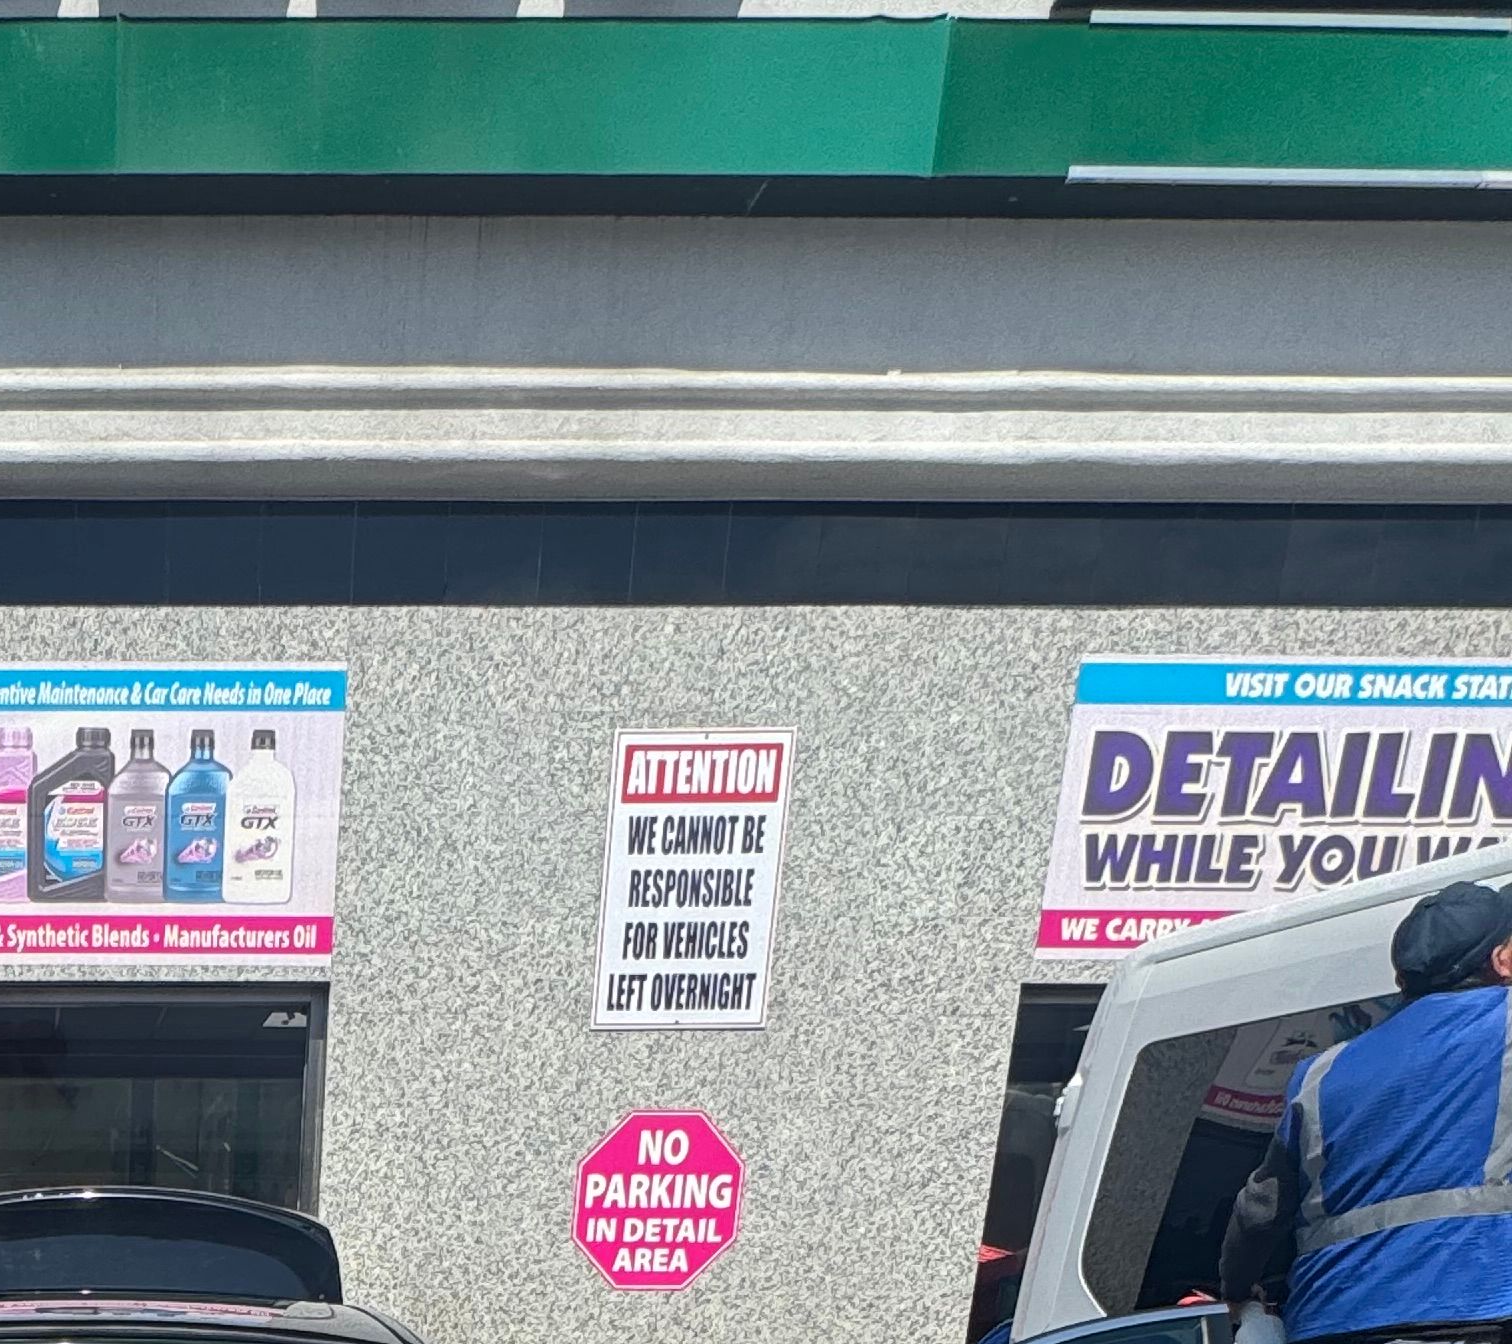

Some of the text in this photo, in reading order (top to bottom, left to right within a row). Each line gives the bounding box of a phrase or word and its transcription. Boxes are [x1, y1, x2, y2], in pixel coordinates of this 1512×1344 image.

[37, 681, 127, 705] Maintenance
[128, 682, 142, 705] &
[143, 682, 169, 705] Car
[170, 682, 200, 705] Care
[200, 682, 245, 705] Needs
[245, 683, 262, 705] in
[263, 683, 292, 705] One
[293, 682, 332, 706] Place
[1224, 671, 1287, 698] VISIT
[1293, 672, 1352, 699] OUR
[1357, 672, 1449, 700] SNACK
[626, 748, 777, 796] ATTENTION
[122, 814, 155, 828] GTX
[180, 814, 215, 826] GTX
[240, 816, 279, 830] GTX
[626, 814, 767, 857] WE CANNOT BE
[1082, 832, 1270, 891] WHILE
[1278, 832, 1406, 889] YOU
[628, 867, 755, 910] RESPONSIBLE
[6, 923, 88, 953] Synthetic
[92, 924, 150, 949] Blends
[164, 923, 290, 950] Manufacturers
[293, 924, 318, 949] Oil
[621, 921, 750, 962] FOR VEHICLES
[1060, 917, 1100, 942] WE
[605, 972, 757, 1012] LEFT OVERNIGHT
[637, 1128, 690, 1167] NO
[585, 1172, 734, 1210] PARKING
[586, 1216, 723, 1244] IN DETAIL
[611, 1247, 689, 1274] AREA
